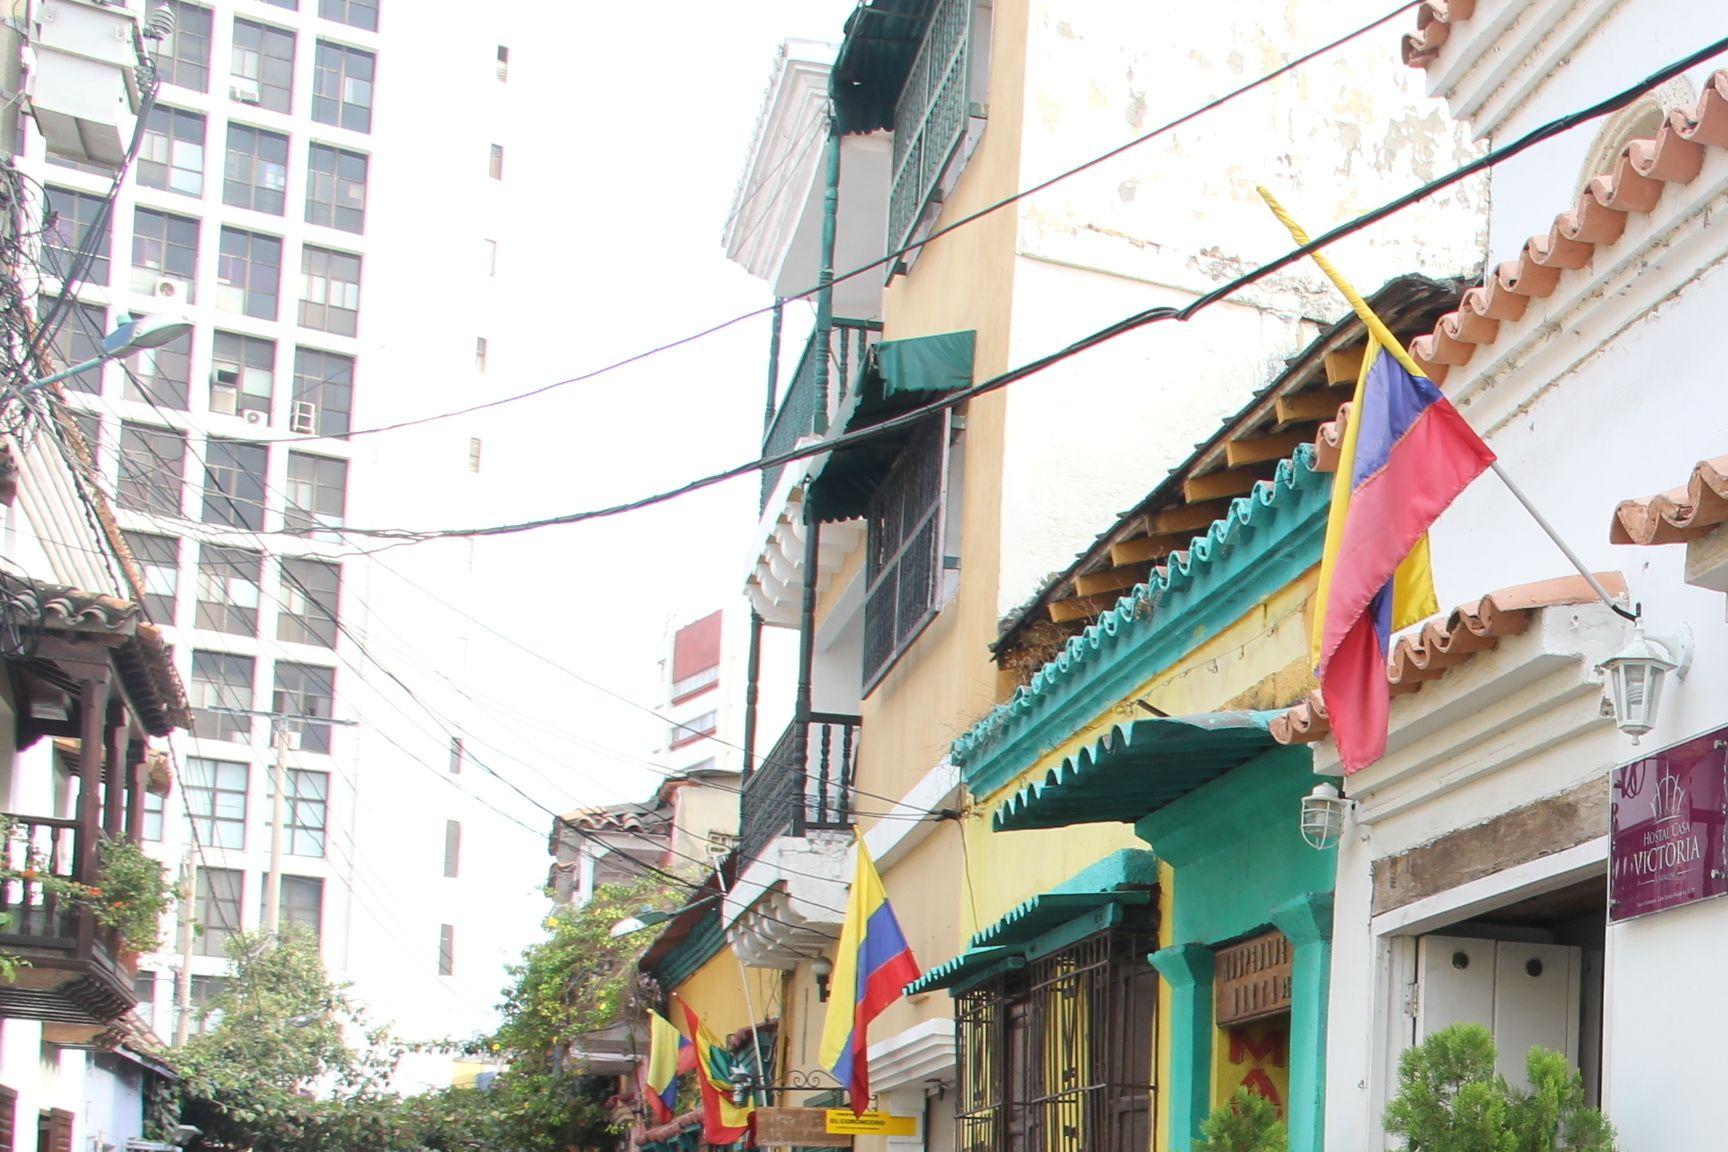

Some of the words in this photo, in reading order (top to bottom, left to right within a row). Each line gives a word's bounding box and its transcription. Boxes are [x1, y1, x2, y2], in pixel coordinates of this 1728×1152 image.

[1643, 827, 1669, 847] HOSTAL
[1671, 821, 1691, 837] CASA
[1633, 835, 1700, 876] VICTORIA
